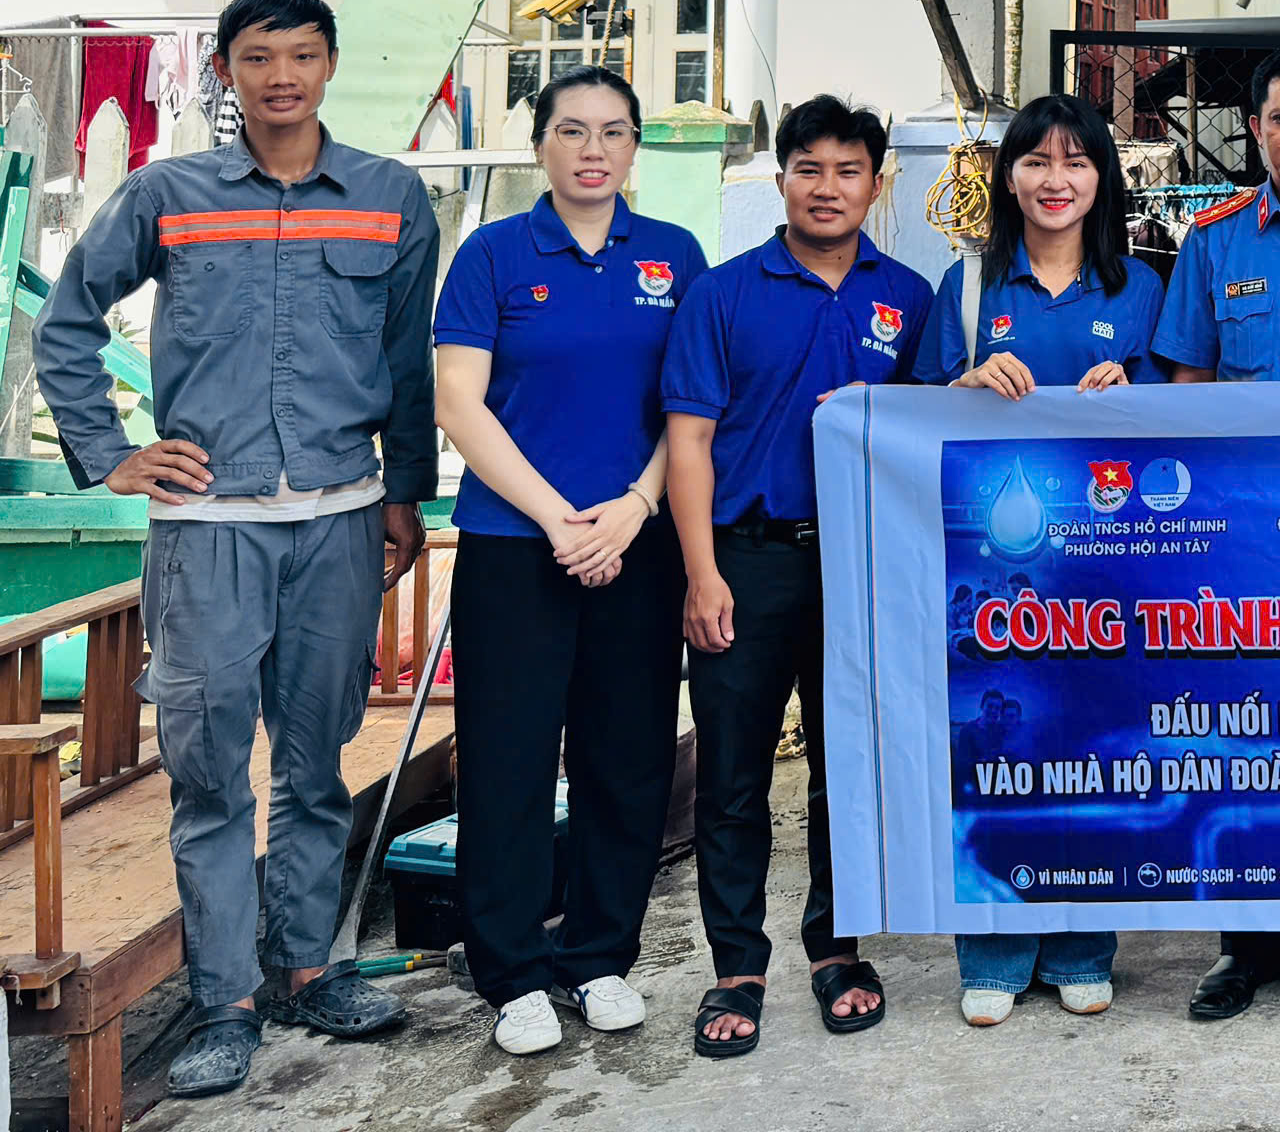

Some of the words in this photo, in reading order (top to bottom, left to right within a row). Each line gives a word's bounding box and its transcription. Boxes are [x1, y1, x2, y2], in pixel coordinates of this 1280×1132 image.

[1048, 521, 1090, 536] ĐOÀN
[1095, 523, 1130, 534] TNCS
[1135, 516, 1155, 533] HỒ
[1160, 518, 1186, 533] CHÍ
[1190, 520, 1226, 532] MINH
[1065, 541, 1126, 555] PHƯỜNG
[1131, 539, 1155, 557] HỘI
[1160, 542, 1180, 553] AN
[1185, 538, 1209, 552] TÂY
[974, 588, 1125, 651] CÔNG
[1151, 692, 1210, 736] ĐẤU
[1220, 692, 1269, 735] NỐI
[976, 756, 1033, 795] VÀO
[1043, 754, 1104, 794] NHÀ
[1113, 753, 1151, 799] HỘ
[1162, 752, 1221, 791] DÂN
[1039, 869, 1050, 884] VÌ
[1053, 869, 1086, 884] NHÂN
[1089, 868, 1113, 884] DÂN
[1167, 867, 1198, 883] NƯỚC
[1202, 869, 1233, 885] SẠCH
[1245, 866, 1276, 884] CUỘC
